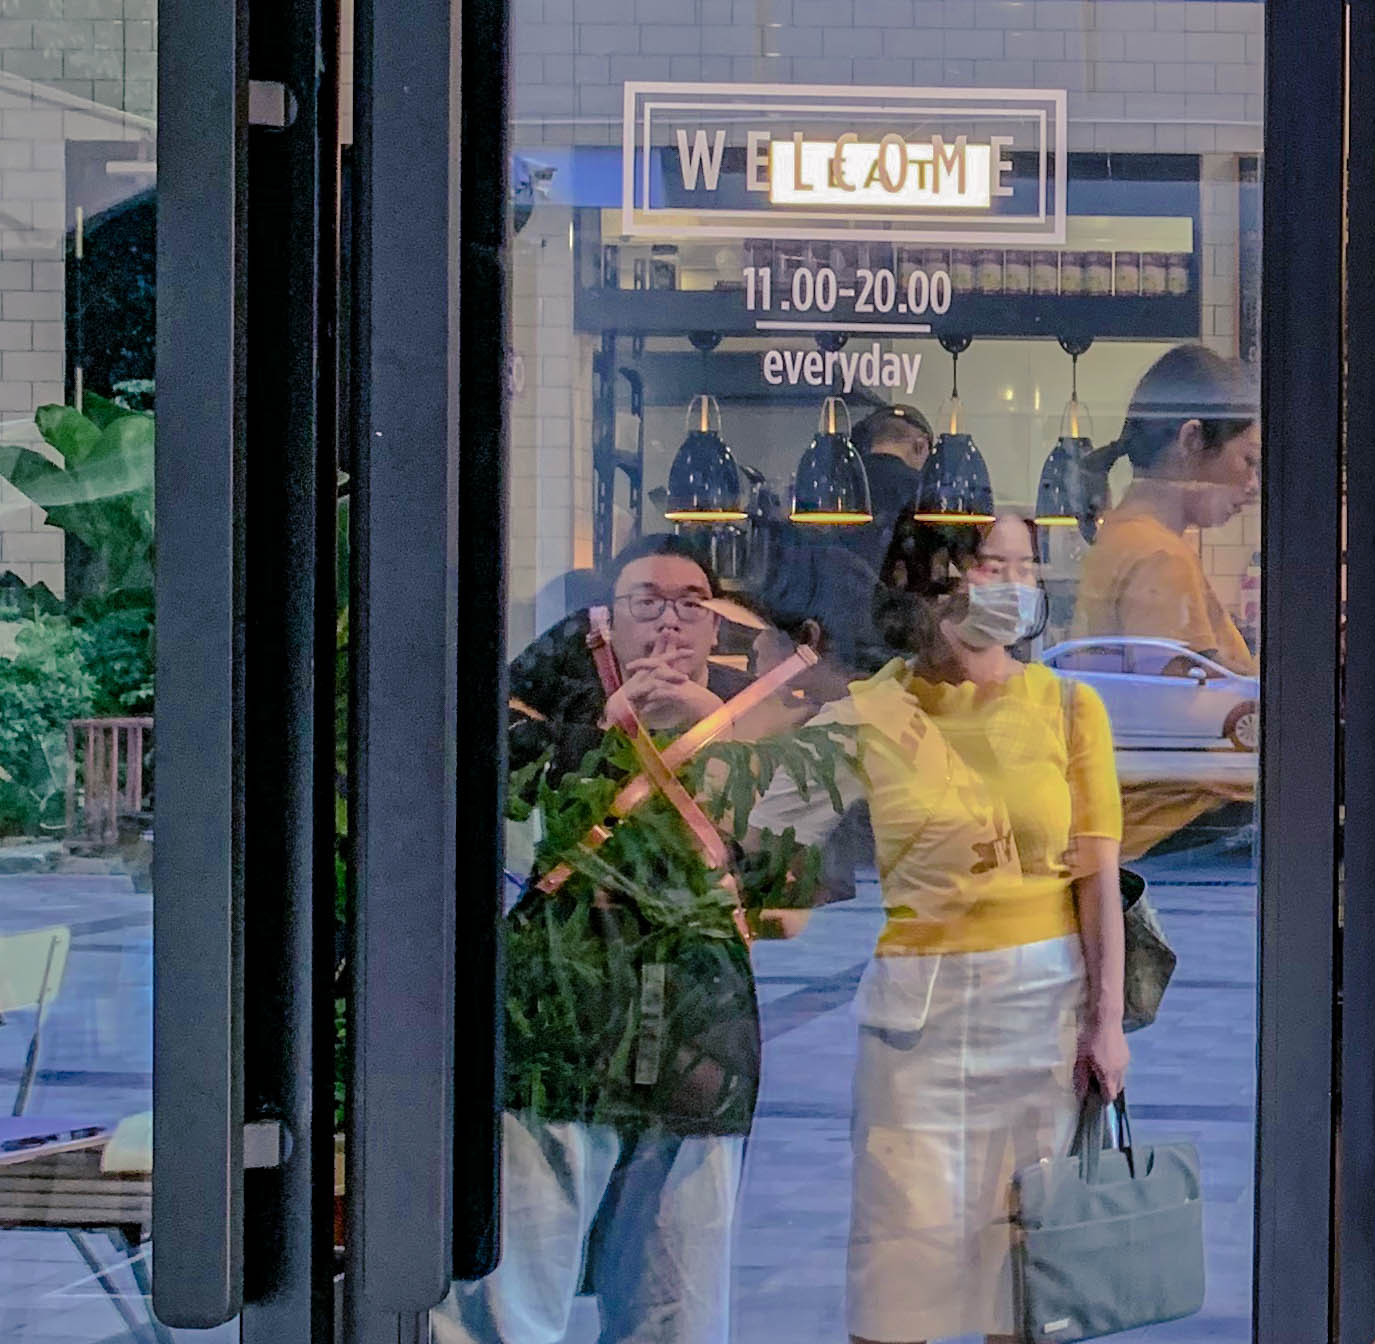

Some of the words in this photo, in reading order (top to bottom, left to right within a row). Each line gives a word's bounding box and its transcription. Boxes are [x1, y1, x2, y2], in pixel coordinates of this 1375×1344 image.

[676, 129, 1015, 197] WELCOME
[743, 266, 952, 316] 11.00-20.00
[762, 342, 922, 395] everyday
